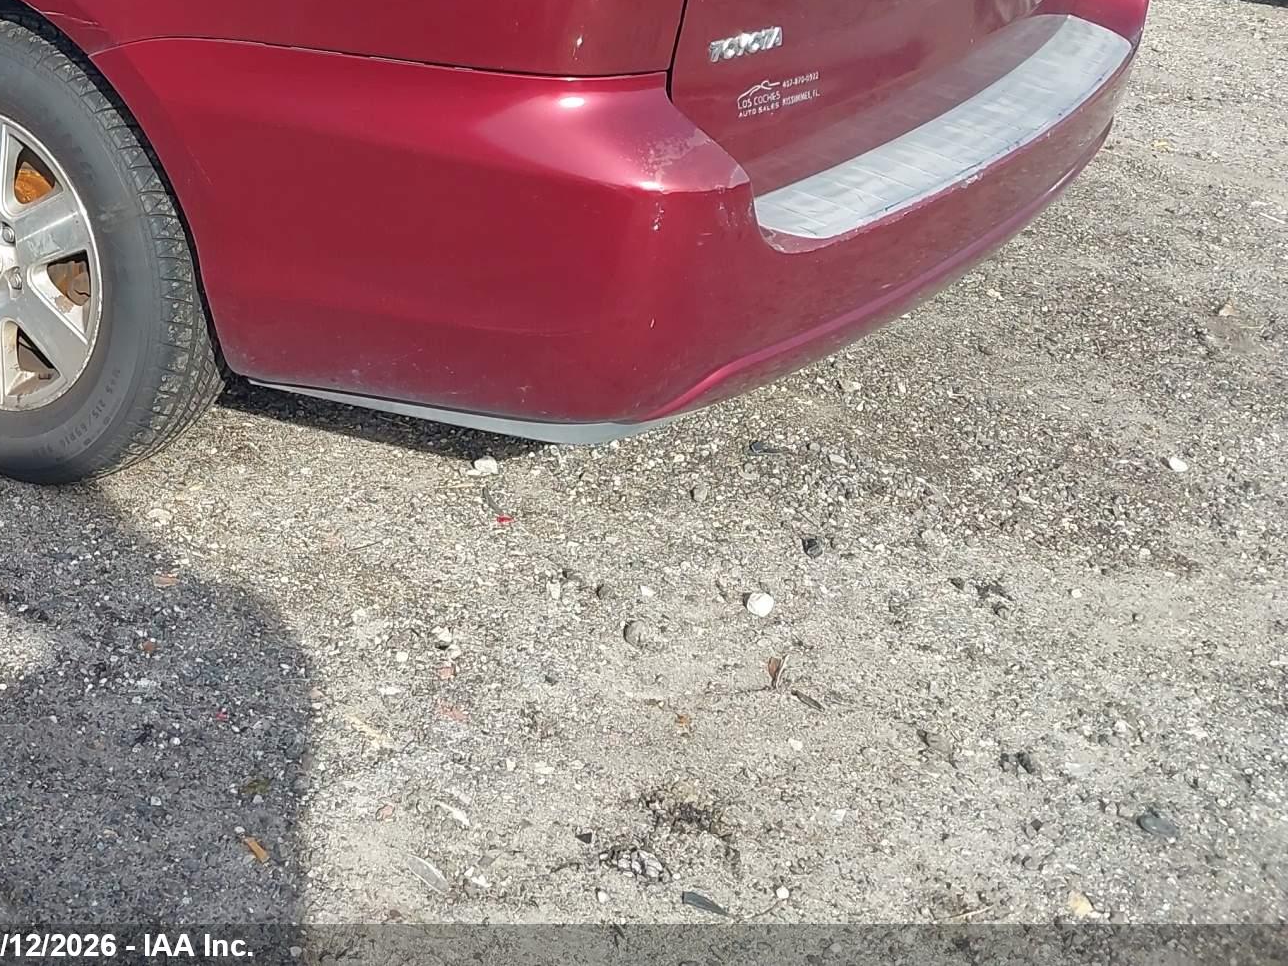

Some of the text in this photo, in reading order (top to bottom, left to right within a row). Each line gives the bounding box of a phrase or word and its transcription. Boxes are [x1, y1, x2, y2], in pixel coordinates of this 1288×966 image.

[709, 26, 783, 62] TOYOTA
[738, 91, 781, 109] LOS COCHES
[738, 102, 780, 118] AUTO SALES
